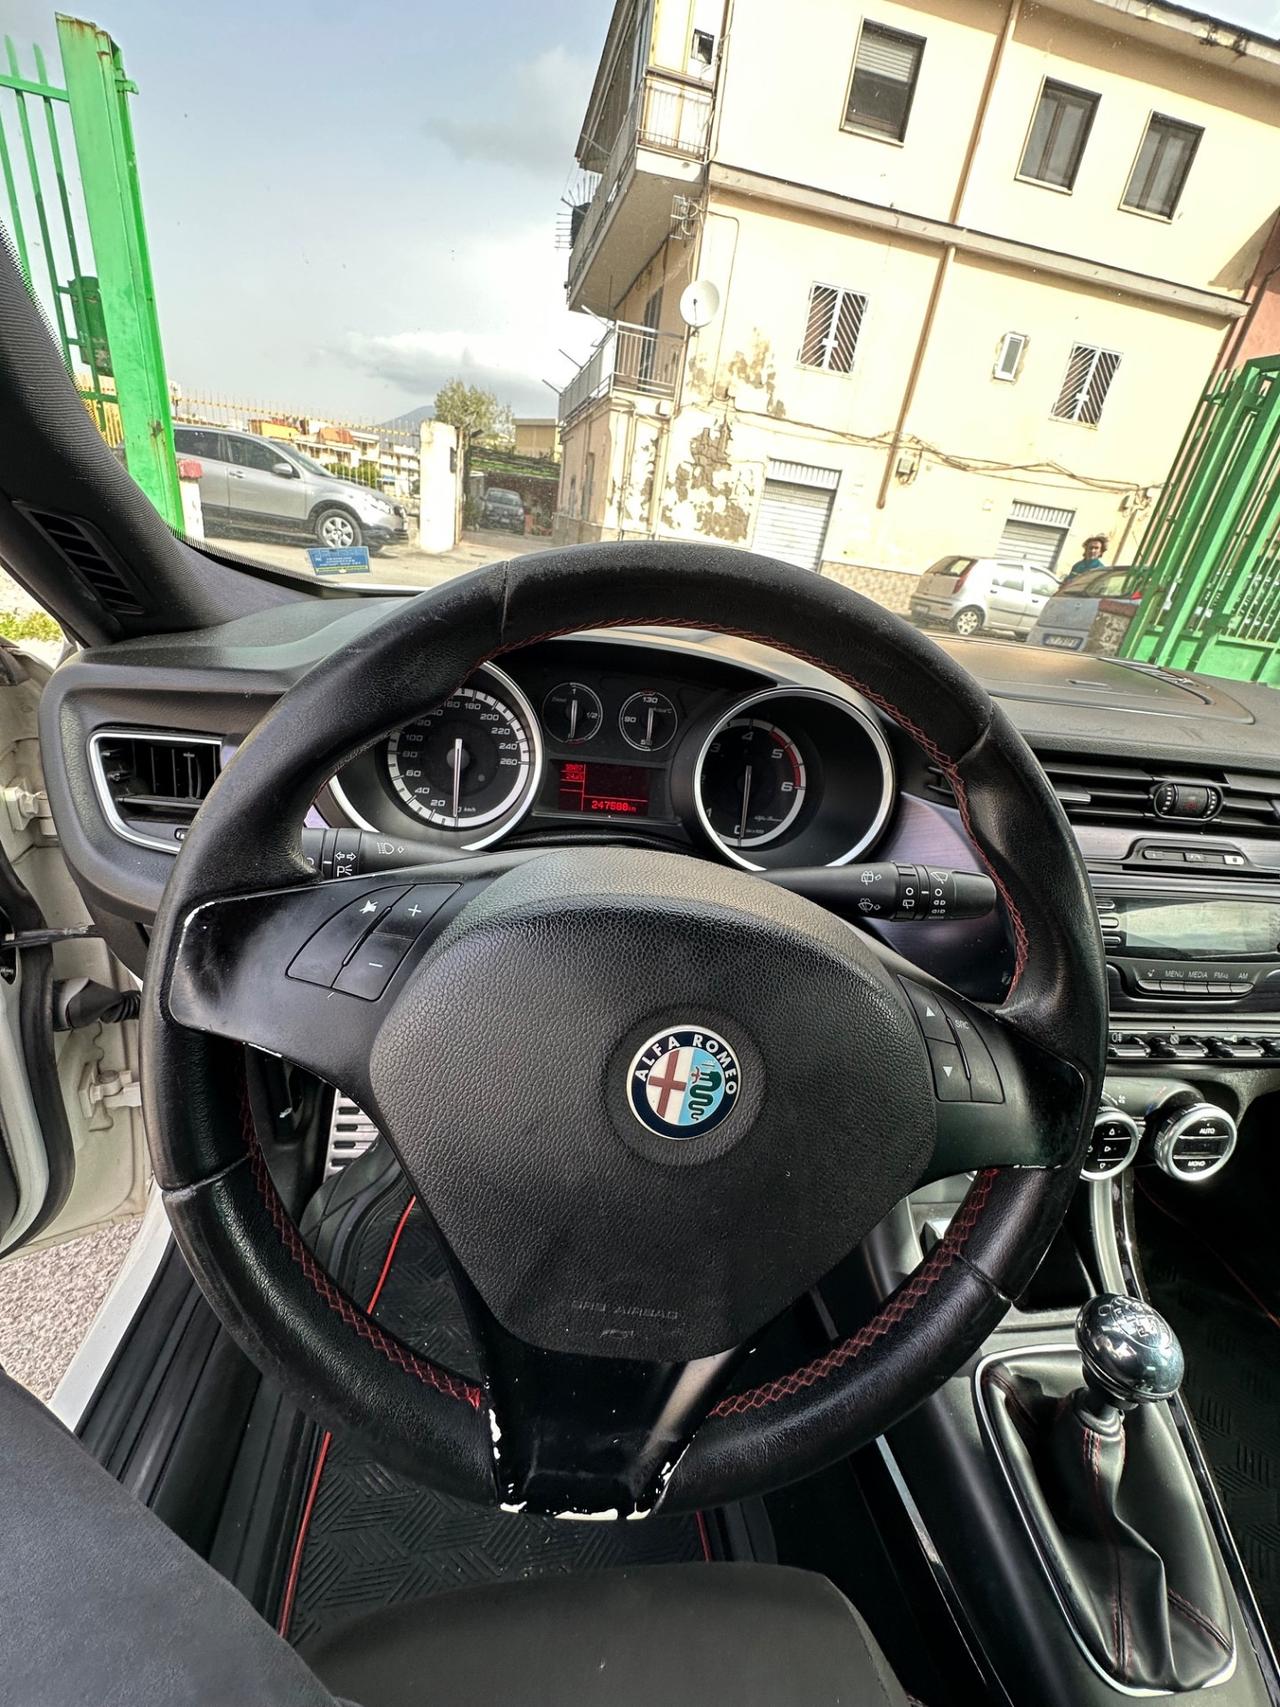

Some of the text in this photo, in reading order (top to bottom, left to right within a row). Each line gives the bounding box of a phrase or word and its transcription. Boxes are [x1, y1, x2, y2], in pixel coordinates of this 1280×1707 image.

[491, 727, 510, 735] 220
[741, 731, 754, 741] 4
[711, 743, 720, 752] 3
[770, 748, 784, 759] 5
[780, 781, 794, 792] 6
[1165, 969, 1185, 979] MENU
[1187, 970, 1208, 980] MEDIA
[634, 1033, 738, 1095] ALFA ROMEO
[1199, 1127, 1216, 1135] AUTO
